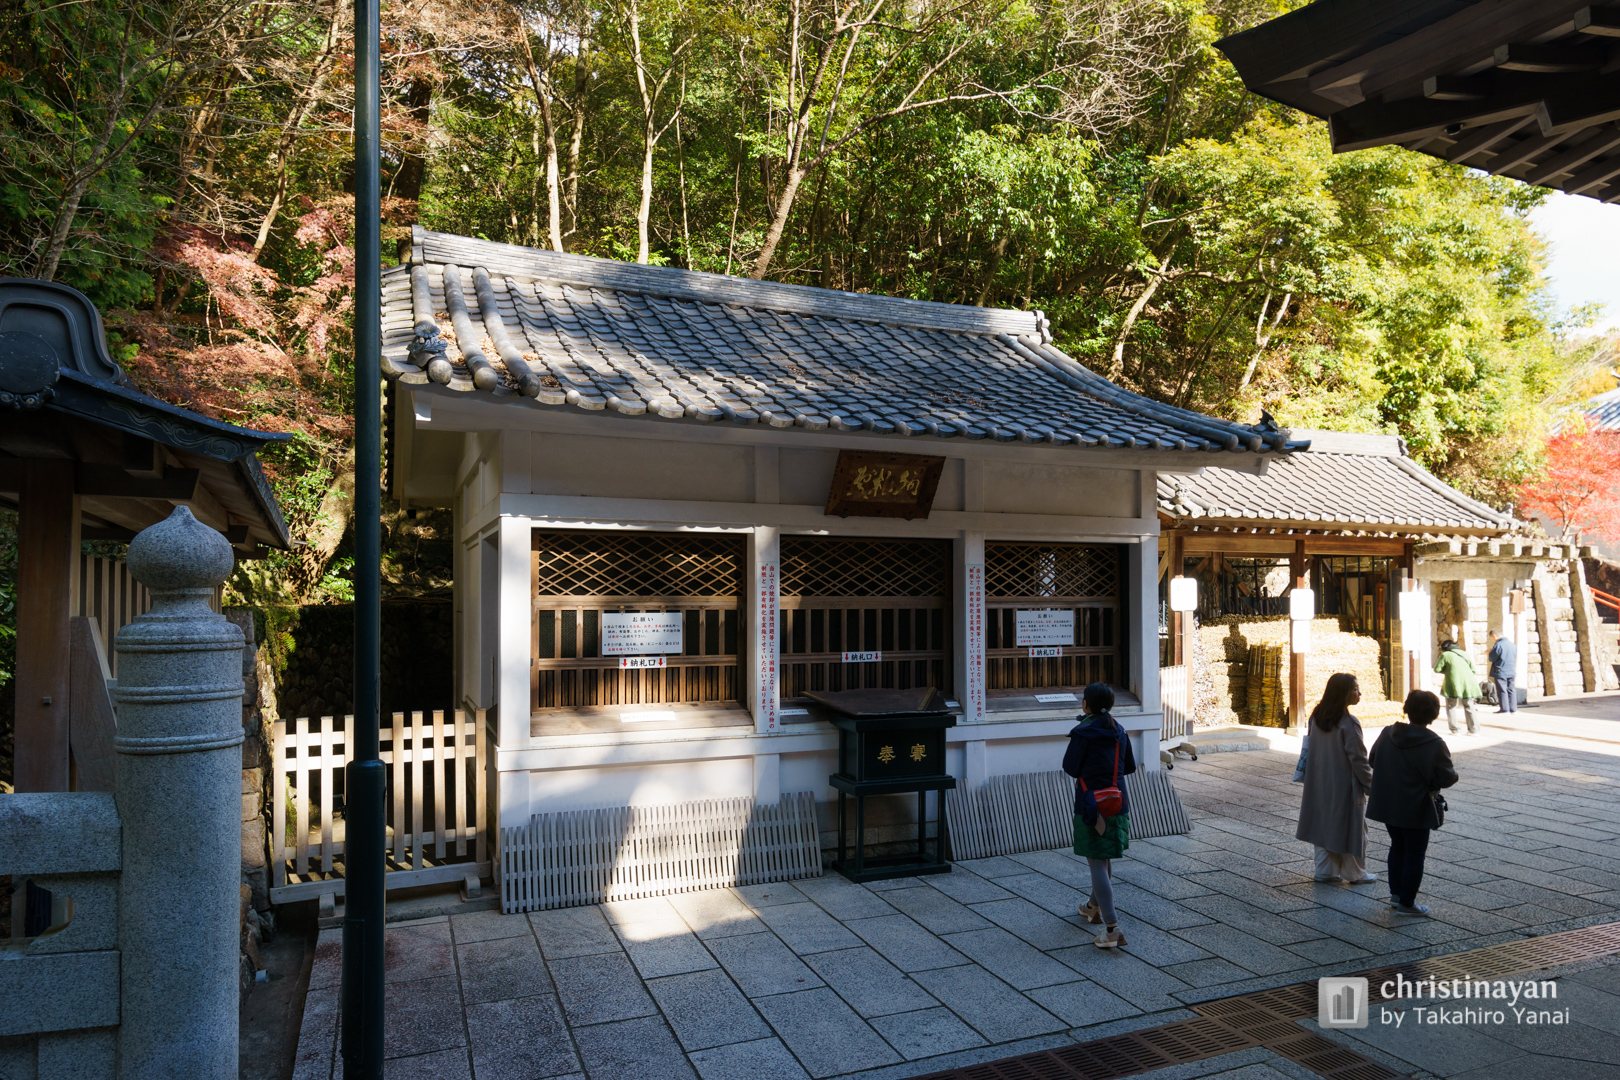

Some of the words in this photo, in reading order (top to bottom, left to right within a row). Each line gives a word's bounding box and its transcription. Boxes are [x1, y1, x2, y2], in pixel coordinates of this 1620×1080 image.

[851, 653, 873, 661] 納札口
[630, 659, 656, 667] 納札口
